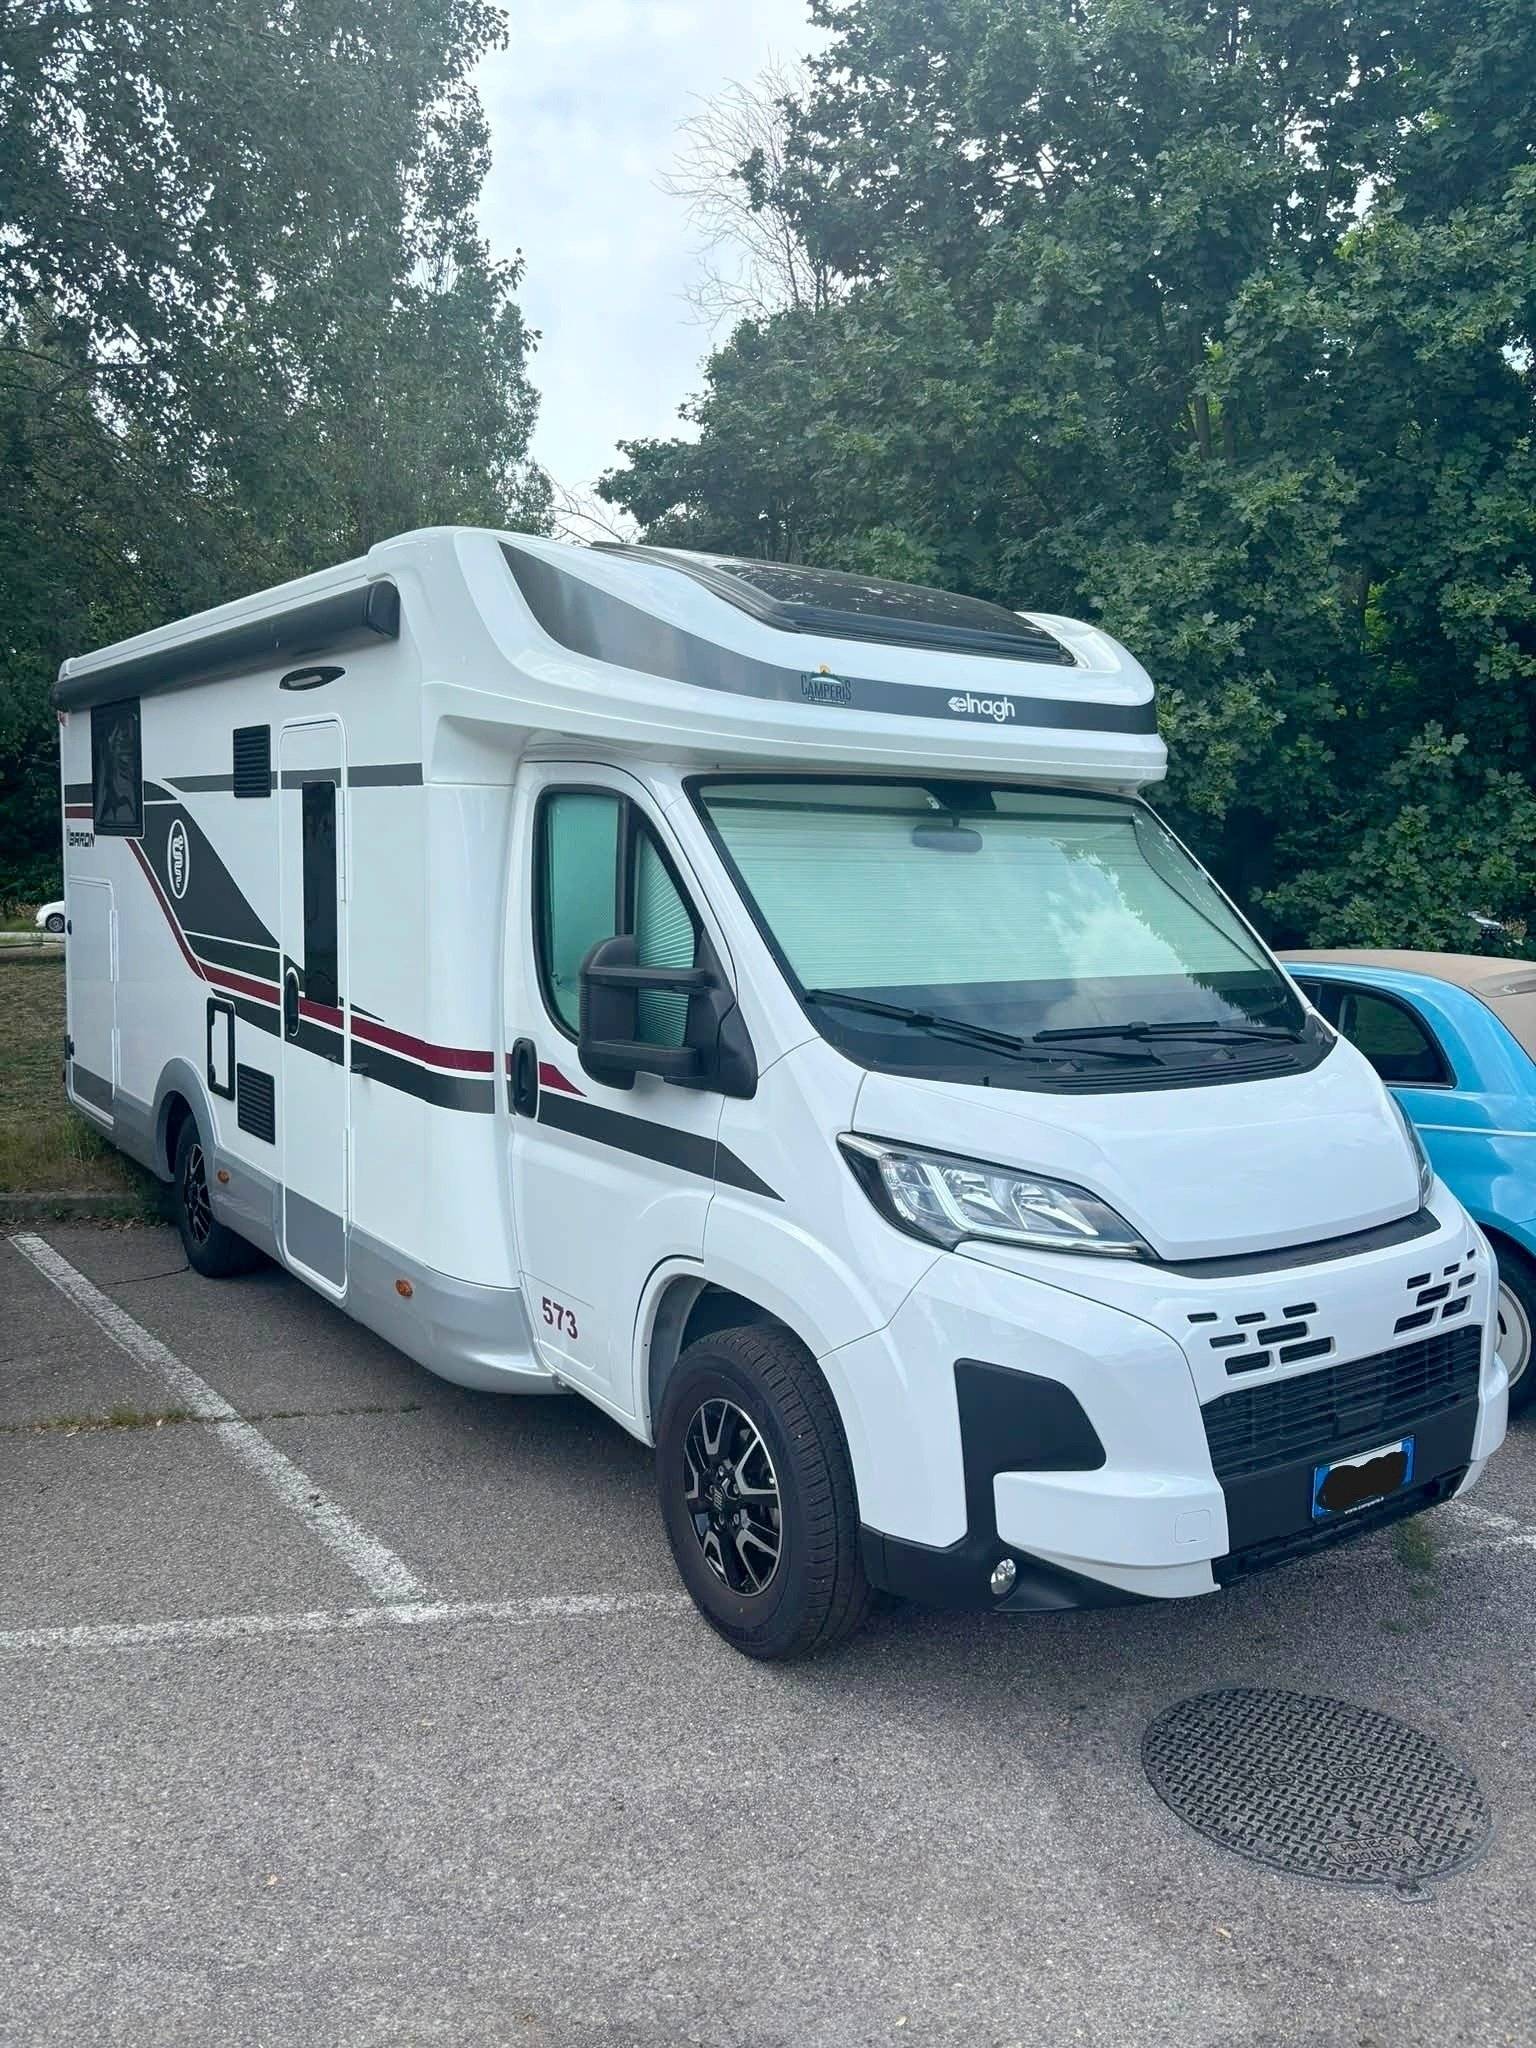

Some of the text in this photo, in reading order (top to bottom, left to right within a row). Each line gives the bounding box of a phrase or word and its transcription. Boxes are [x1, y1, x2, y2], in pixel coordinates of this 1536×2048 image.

[801, 674, 852, 701] CAMPERIS
[953, 692, 1016, 722] elnagh
[542, 1295, 578, 1340] 573
